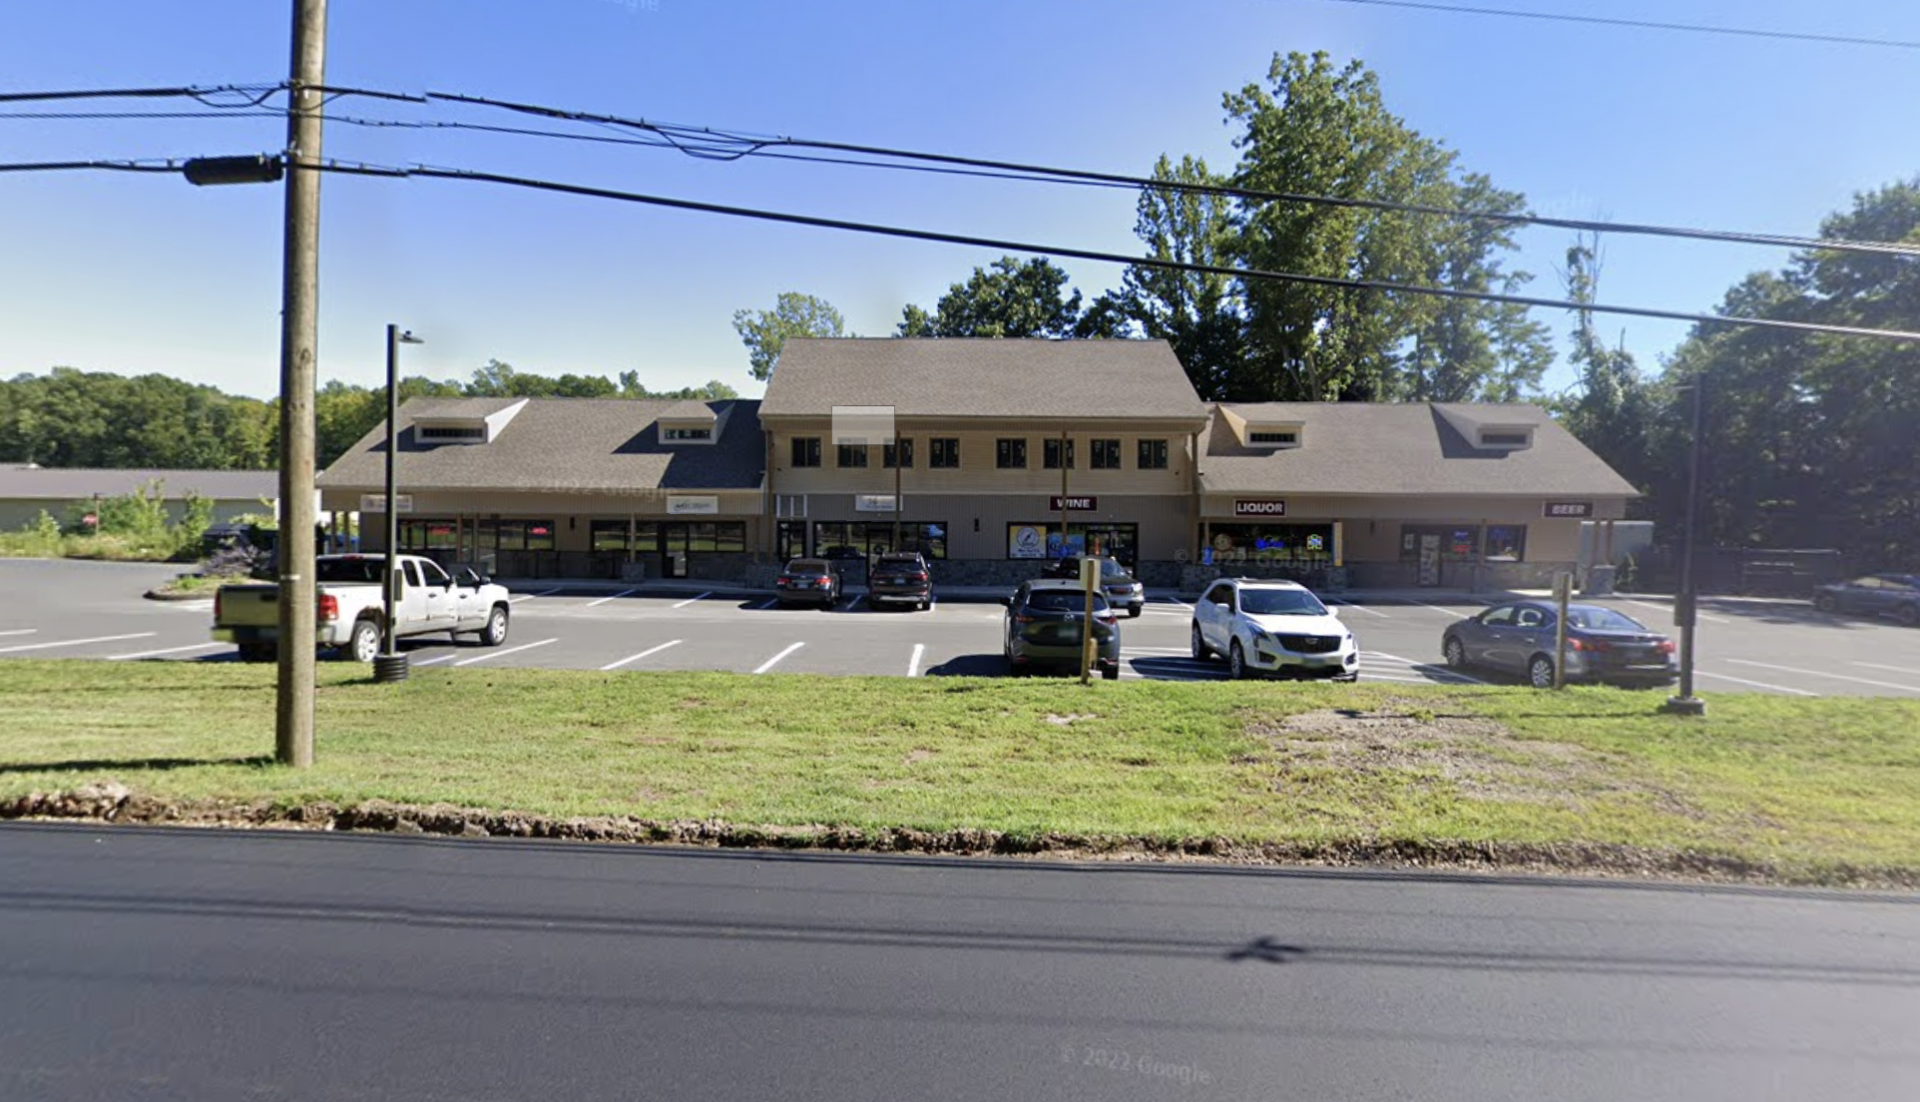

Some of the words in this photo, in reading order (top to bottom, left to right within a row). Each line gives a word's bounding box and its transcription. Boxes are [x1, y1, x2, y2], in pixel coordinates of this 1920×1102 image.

[1056, 498, 1091, 509] WINE
[1236, 502, 1283, 513] LIQUOR
[1551, 504, 1586, 515] BEER
